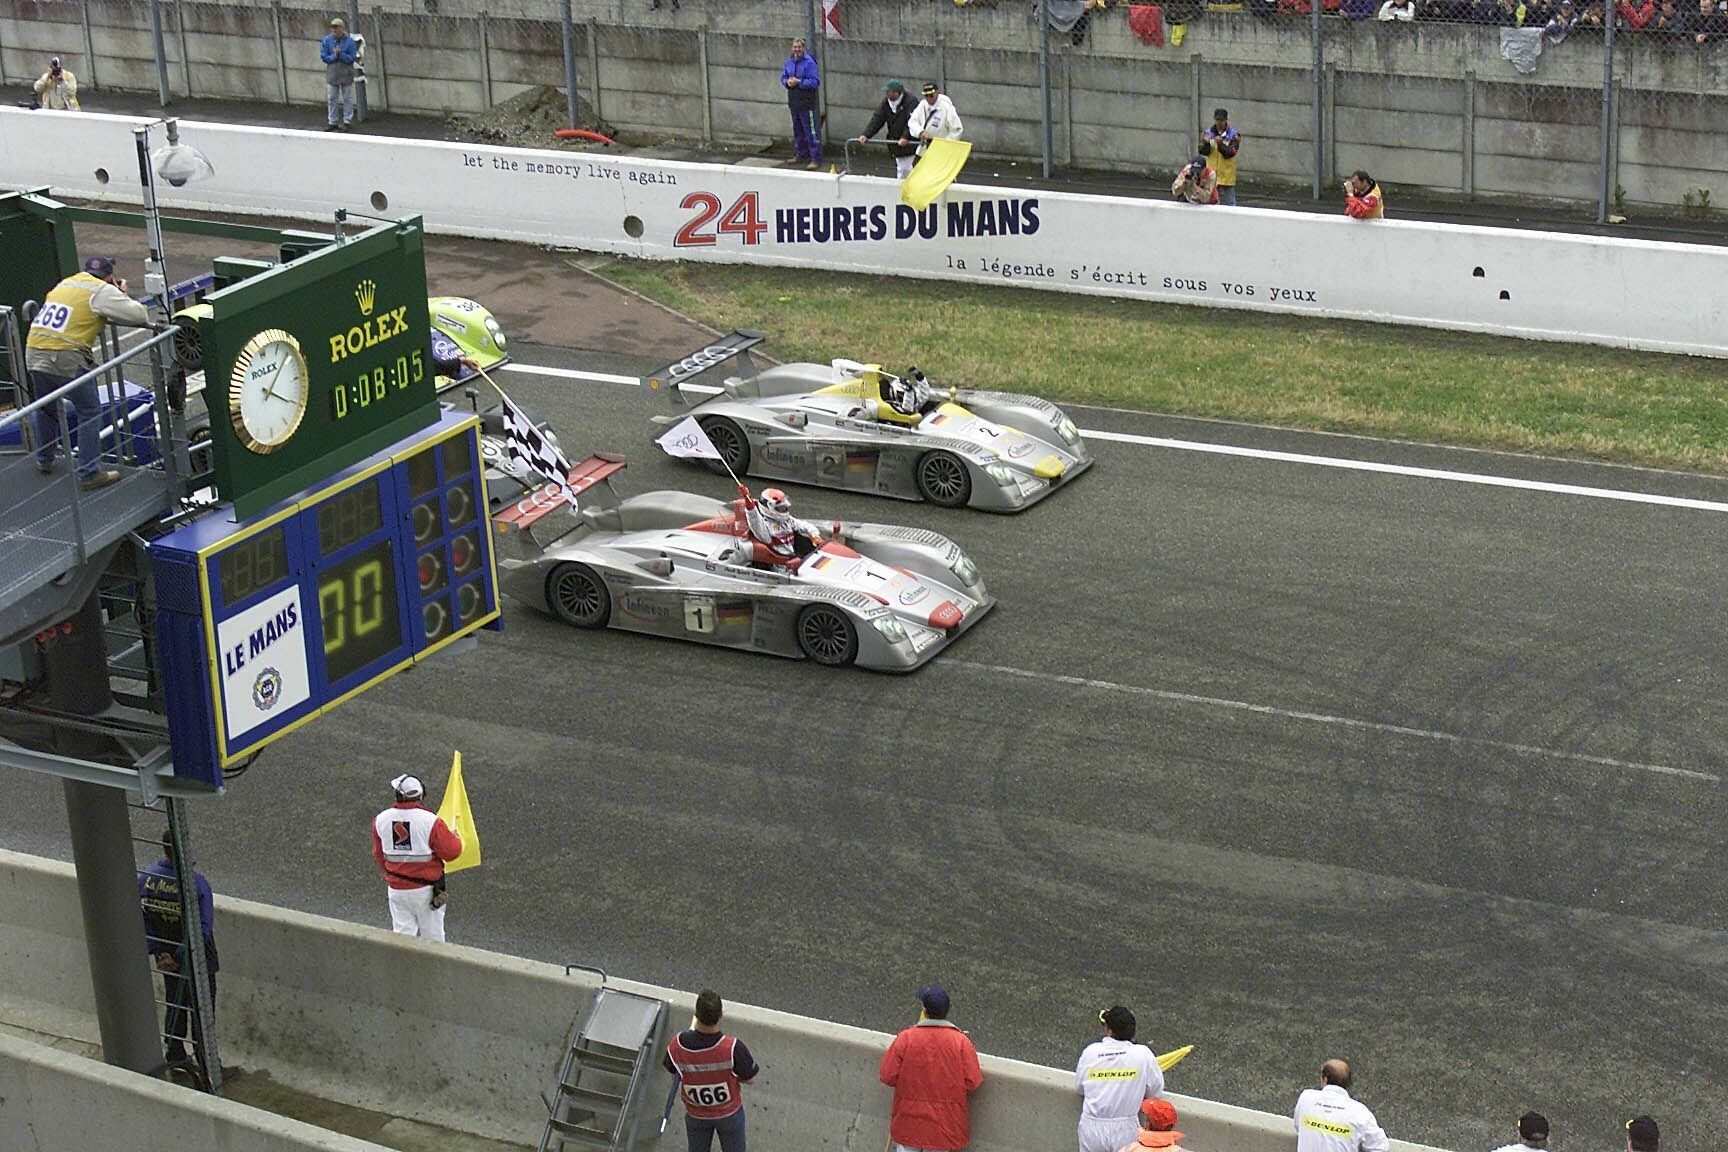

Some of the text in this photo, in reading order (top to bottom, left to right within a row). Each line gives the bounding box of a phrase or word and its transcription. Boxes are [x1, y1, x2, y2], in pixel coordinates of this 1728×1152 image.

[463, 154, 678, 186] let the memory live again
[673, 191, 1041, 248] 24 HEURES DU MANS
[945, 254, 1318, 302] la légende s'écrit sous vos yeux
[329, 305, 409, 364] ROLEX
[251, 362, 278, 381] ROLEX
[335, 349, 425, 418] 0:08:05
[979, 427, 999, 438] 2
[822, 455, 838, 475] 2
[866, 570, 887, 581] 1
[319, 560, 383, 656] 00
[692, 608, 704, 630] 1
[225, 602, 298, 678] LE MANS
[1097, 1070, 1136, 1079] DUNLOP
[688, 1085, 728, 1105] 166
[1310, 1121, 1350, 1134] DUNLOP
